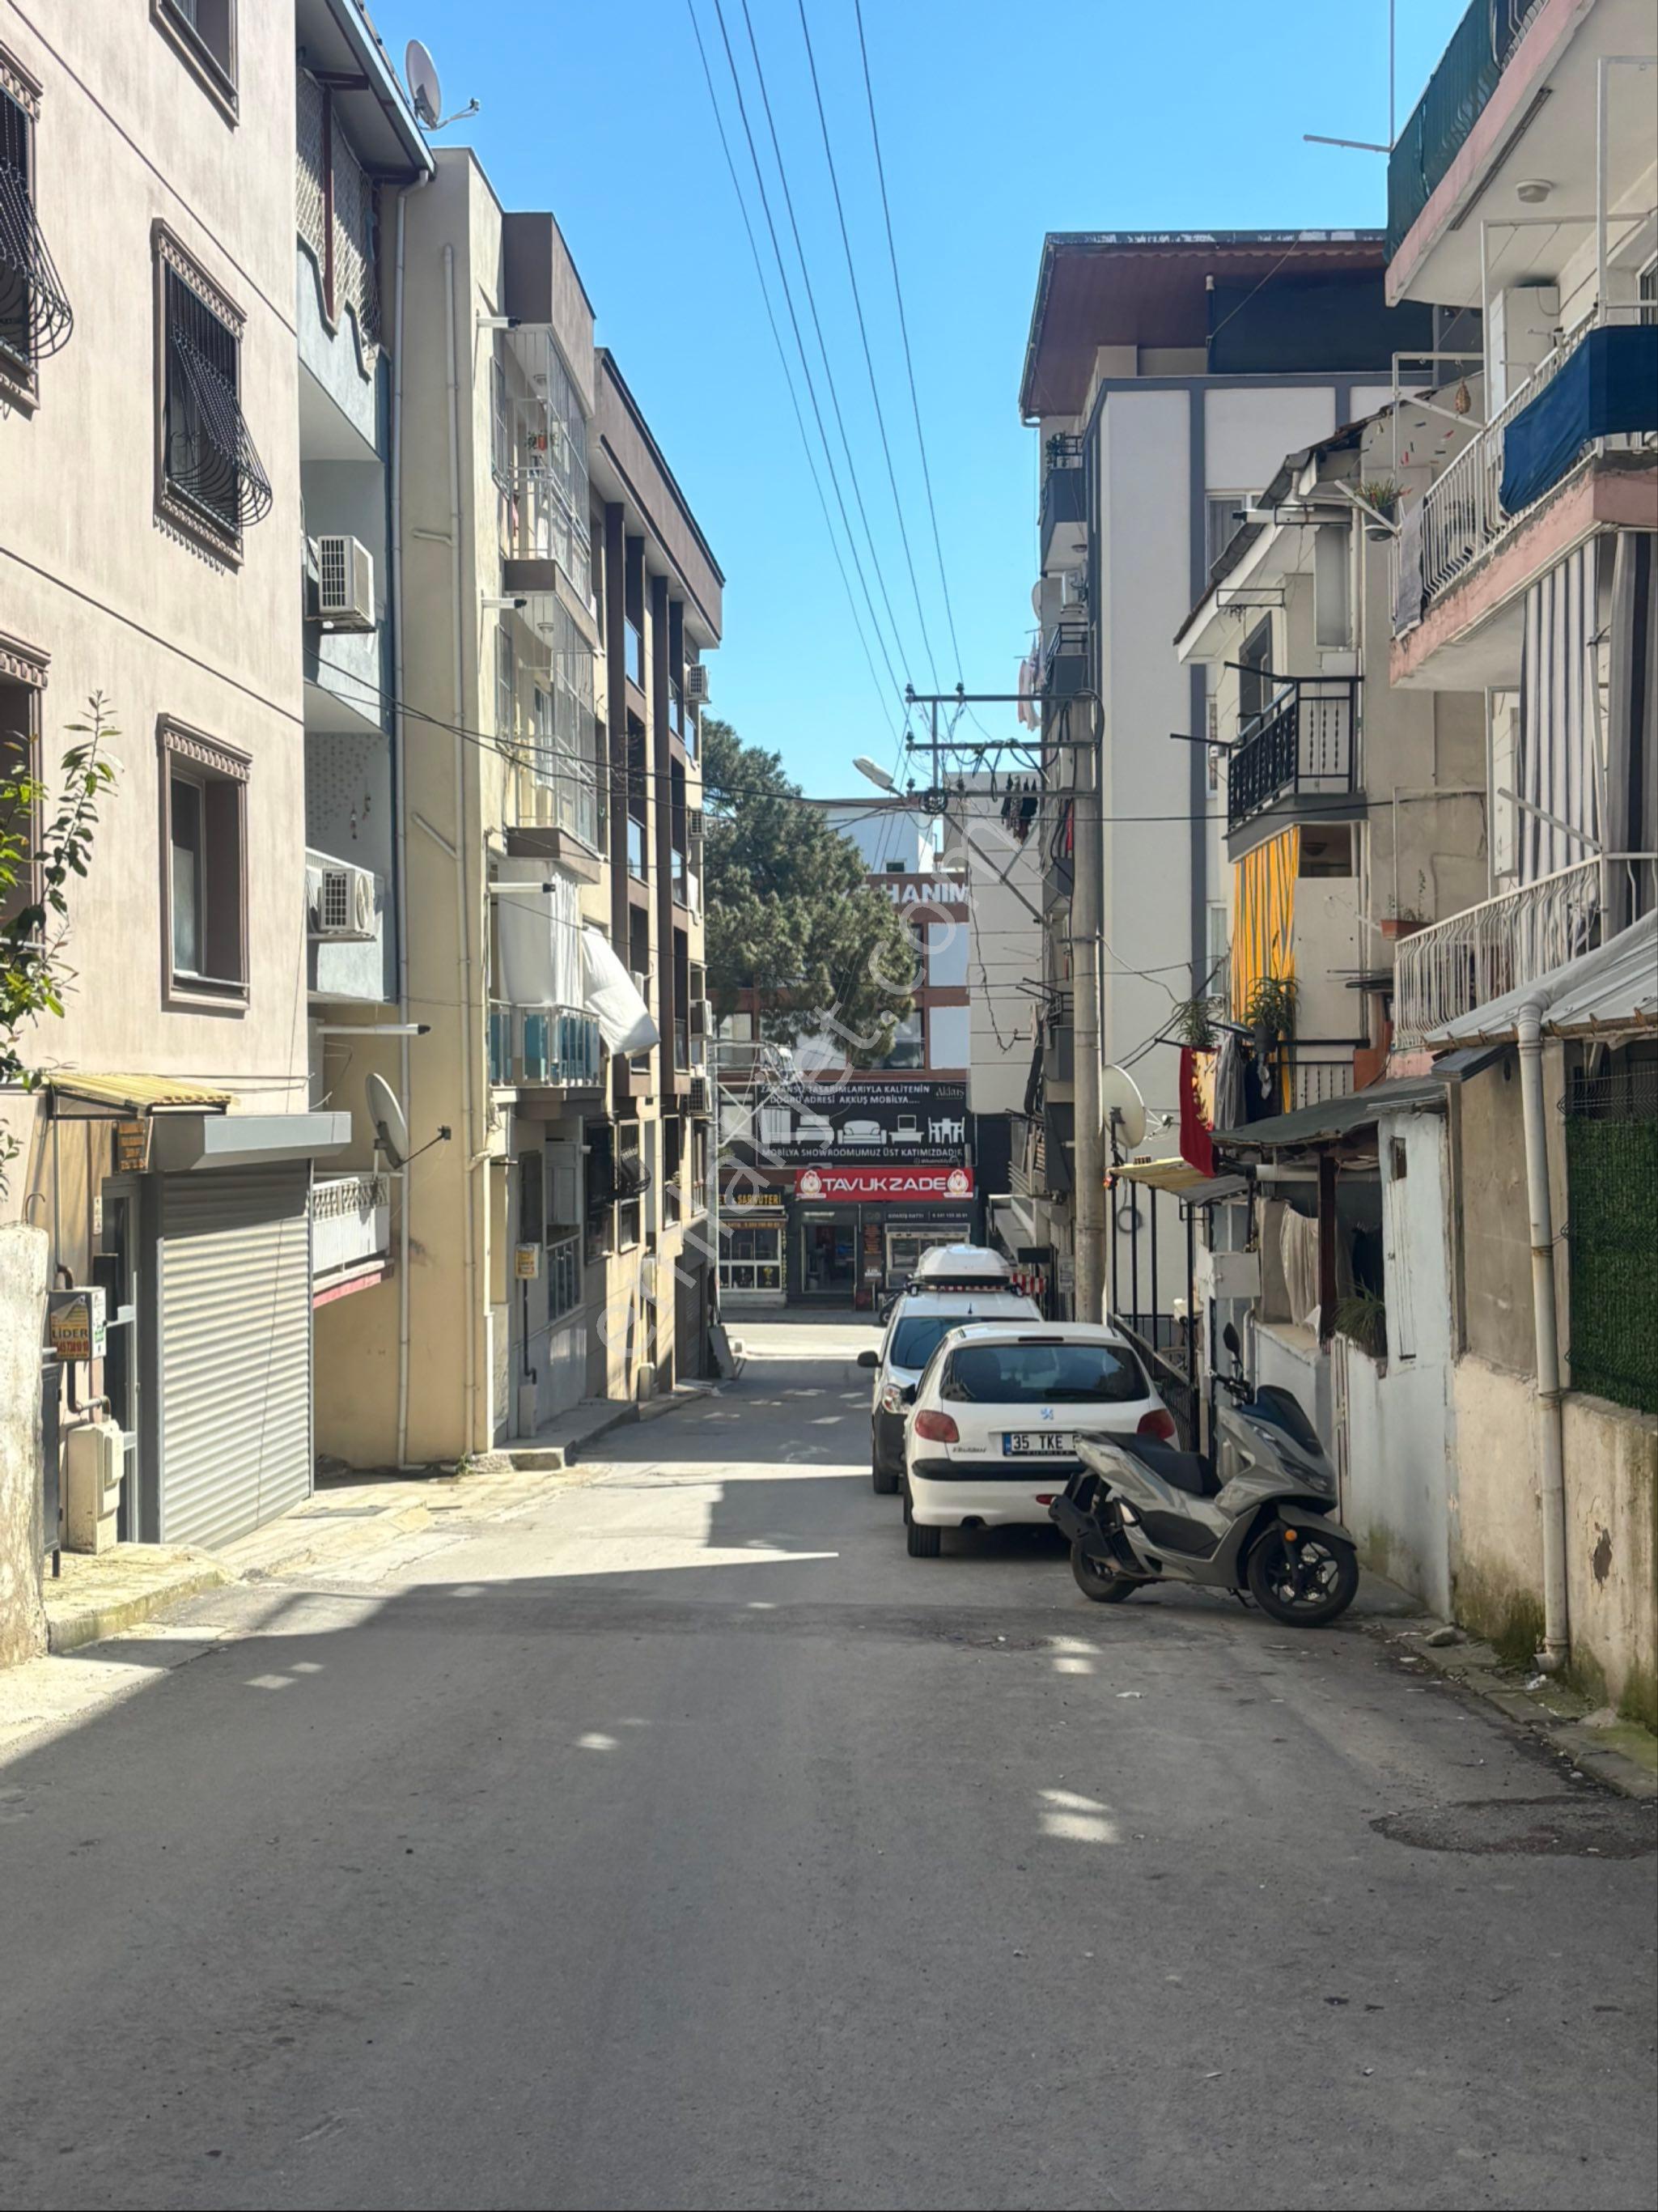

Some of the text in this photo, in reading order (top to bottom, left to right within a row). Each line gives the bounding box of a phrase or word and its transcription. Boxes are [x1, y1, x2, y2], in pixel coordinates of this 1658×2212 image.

[884, 1084, 931, 1093] KALİTENİN
[804, 1094, 835, 1104] ADRESİ
[839, 1095, 868, 1106] AKKUŞ
[801, 1148, 881, 1157] SHOWROOMUMUZ
[883, 1147, 899, 1157] ÜST
[1013, 1434, 1029, 1450] 35
[1039, 1434, 1063, 1450] TKE
